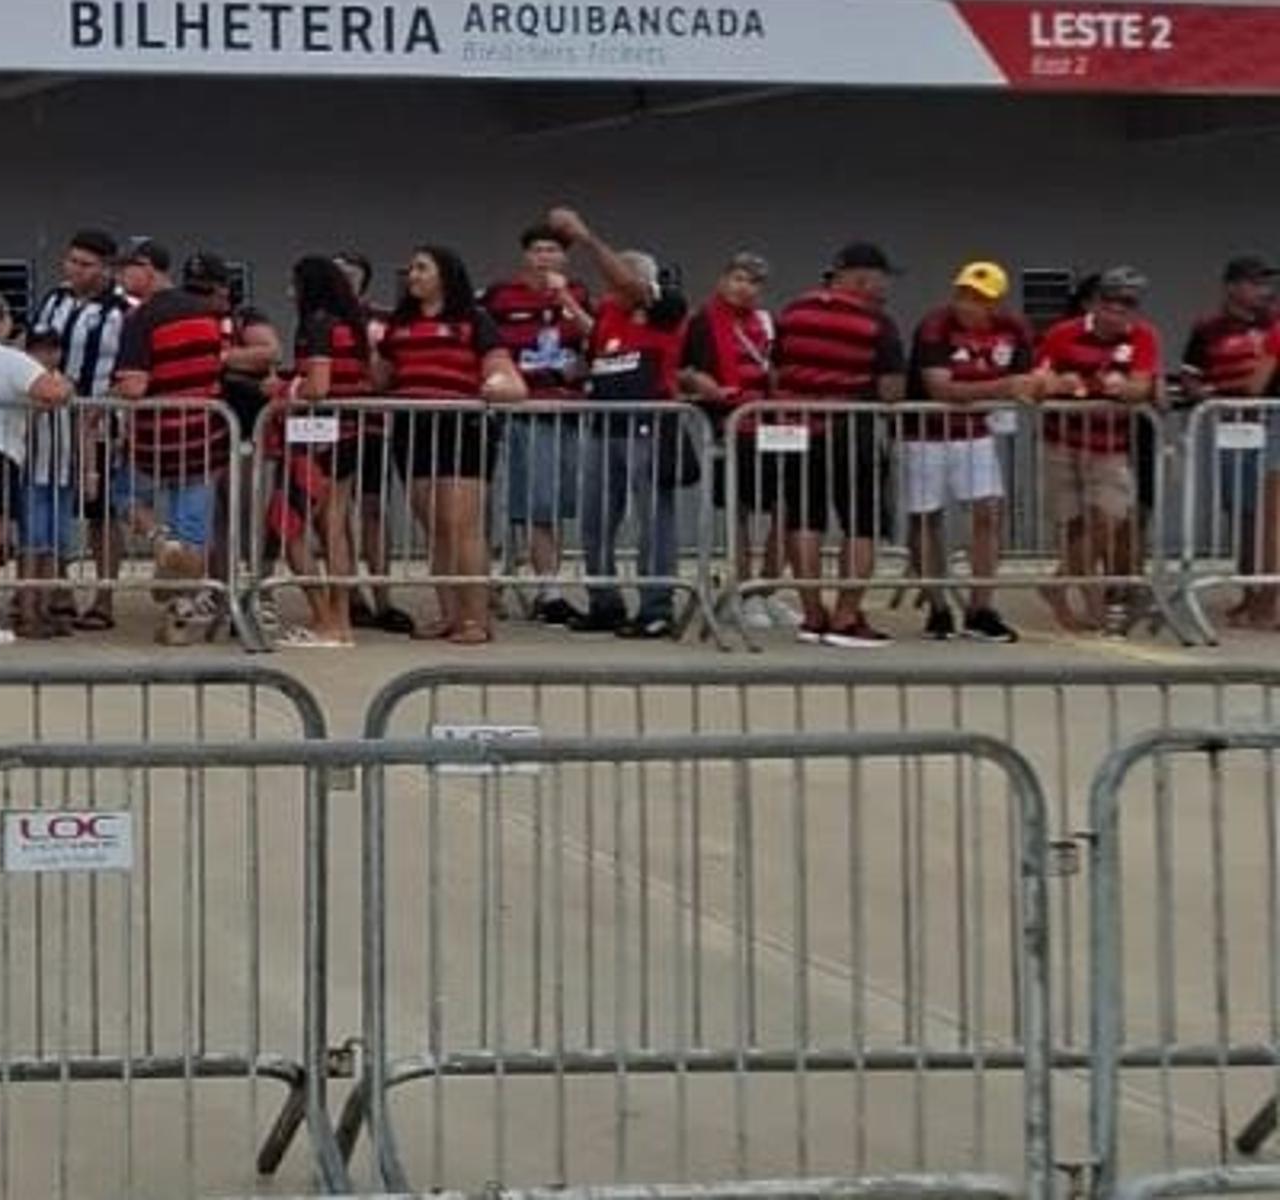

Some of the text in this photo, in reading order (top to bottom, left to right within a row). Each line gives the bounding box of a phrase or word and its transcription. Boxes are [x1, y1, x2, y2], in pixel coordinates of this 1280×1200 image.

[71, 0, 441, 54] BILHETERIA
[463, 3, 765, 37] ARQUIBANCADA
[1030, 11, 1173, 49] LESTE 2
[20, 815, 118, 839] LOC
